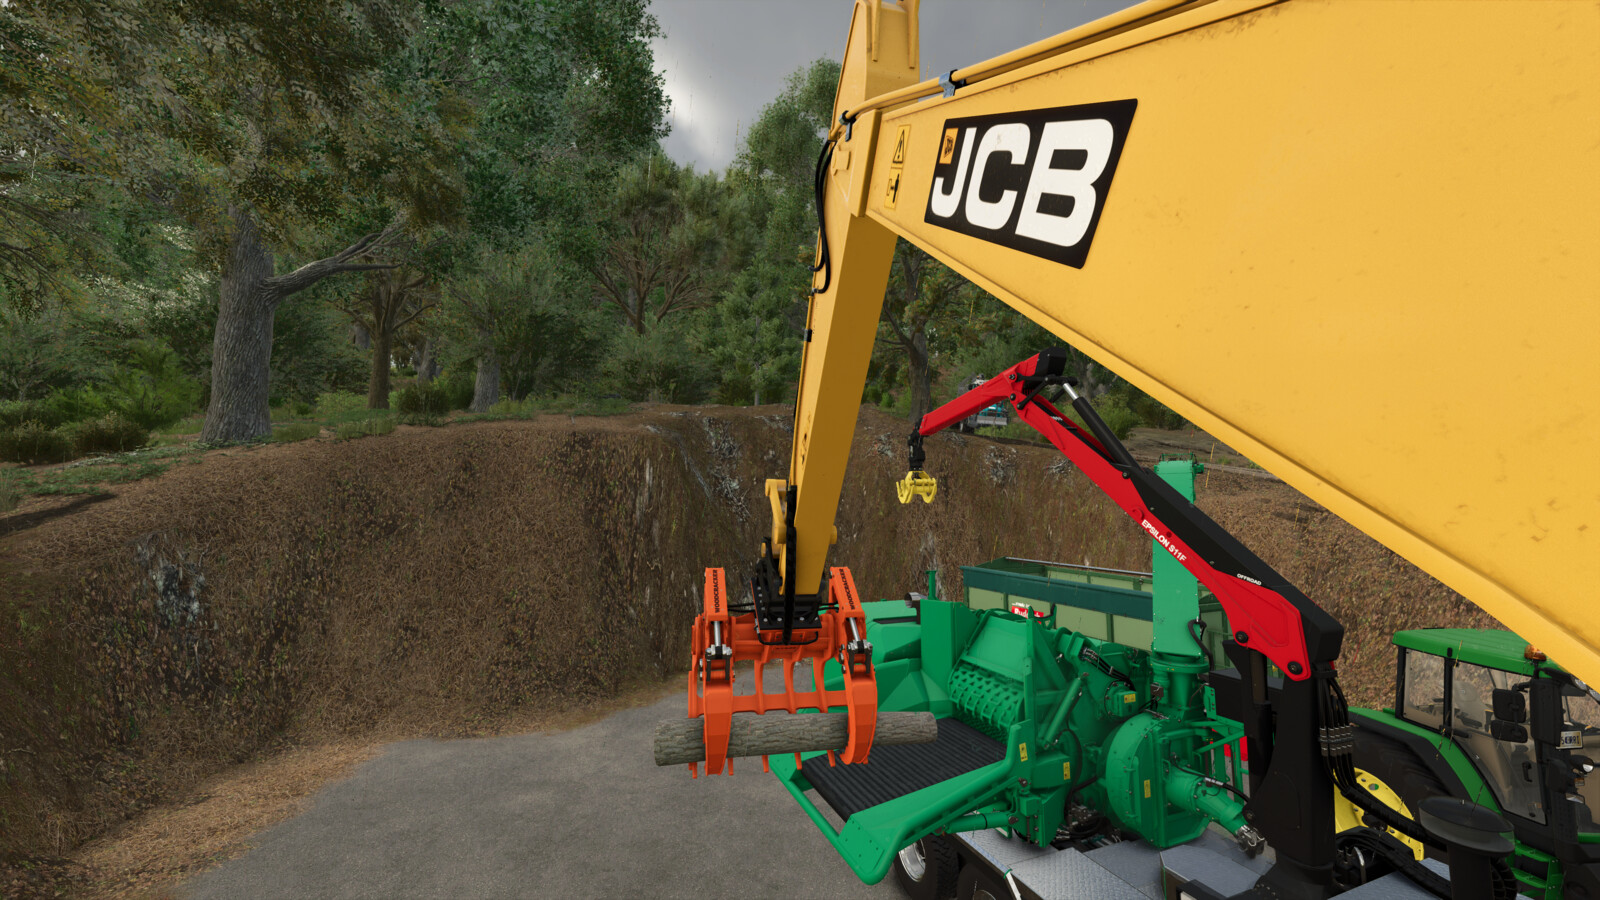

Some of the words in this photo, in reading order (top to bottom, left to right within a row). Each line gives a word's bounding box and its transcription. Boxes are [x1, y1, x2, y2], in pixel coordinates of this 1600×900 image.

[931, 118, 1114, 247] JCB
[1141, 519, 1170, 548] EPSILON
[1168, 544, 1187, 561] S11F
[839, 568, 855, 610] WOODCRACKER
[1236, 573, 1262, 586] OFFROAD
